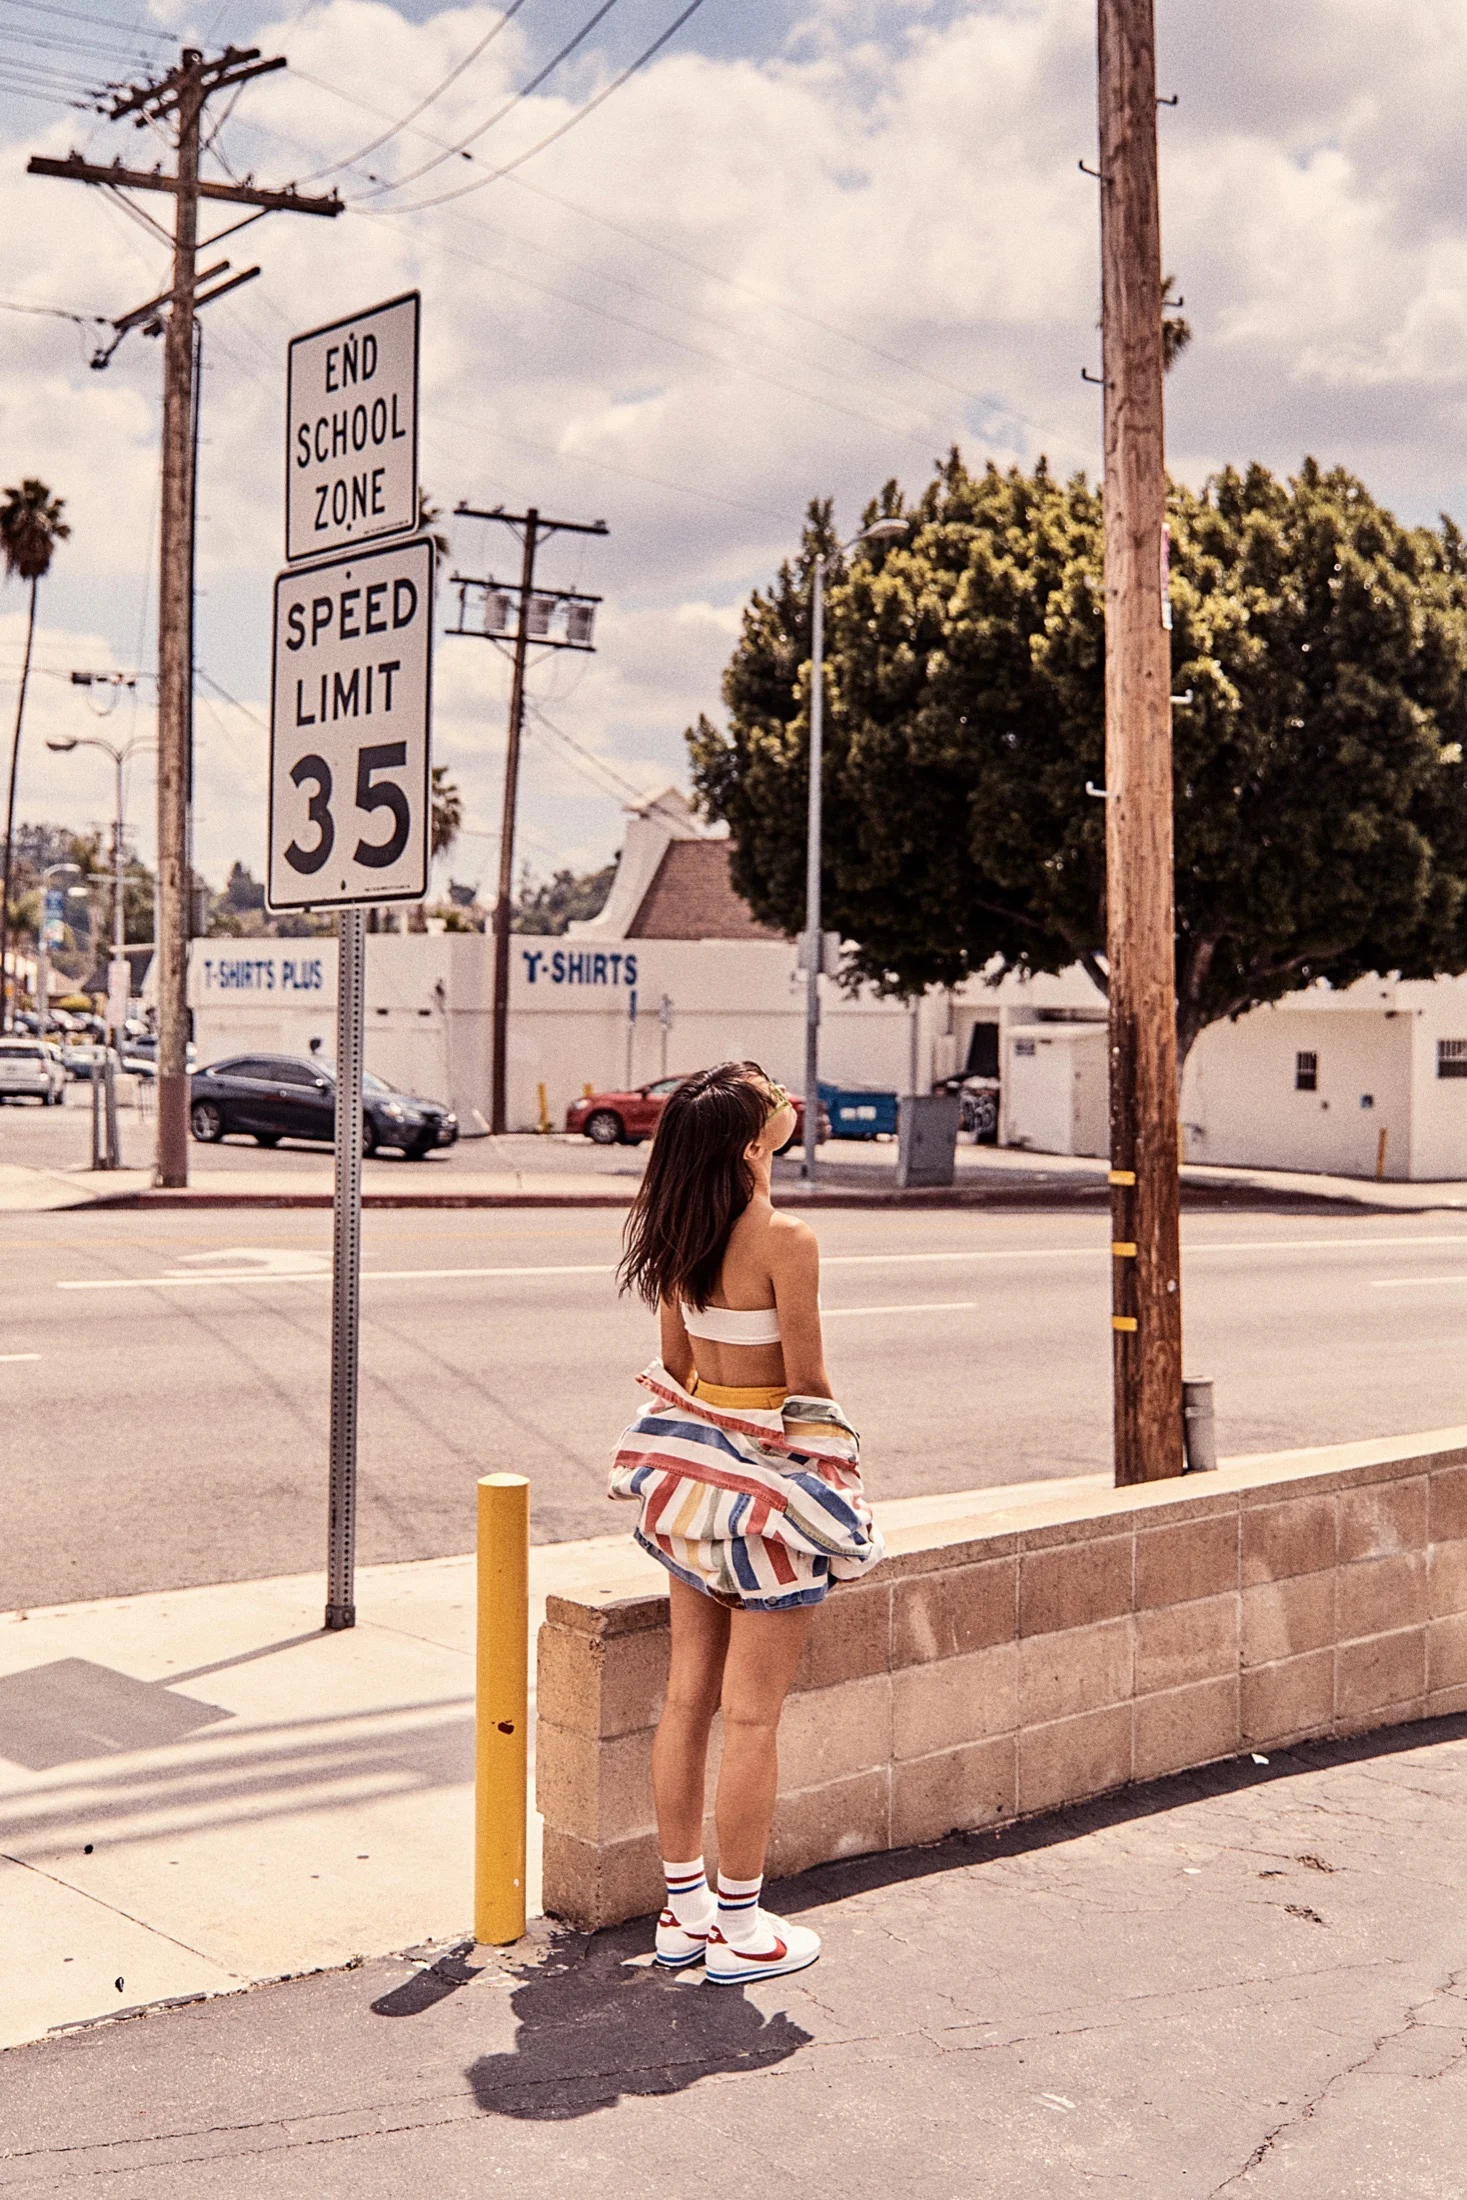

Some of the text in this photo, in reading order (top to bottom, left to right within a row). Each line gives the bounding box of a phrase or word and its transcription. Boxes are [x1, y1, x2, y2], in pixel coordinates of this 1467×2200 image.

[326, 333, 378, 394] END
[297, 393, 407, 469] SCHOOL
[315, 467, 386, 532] ZONE
[285, 577, 418, 652] SPEED
[296, 659, 401, 728] LIMIT
[283, 740, 411, 875] 35
[204, 959, 322, 991] T-SHIRTS PLUS
